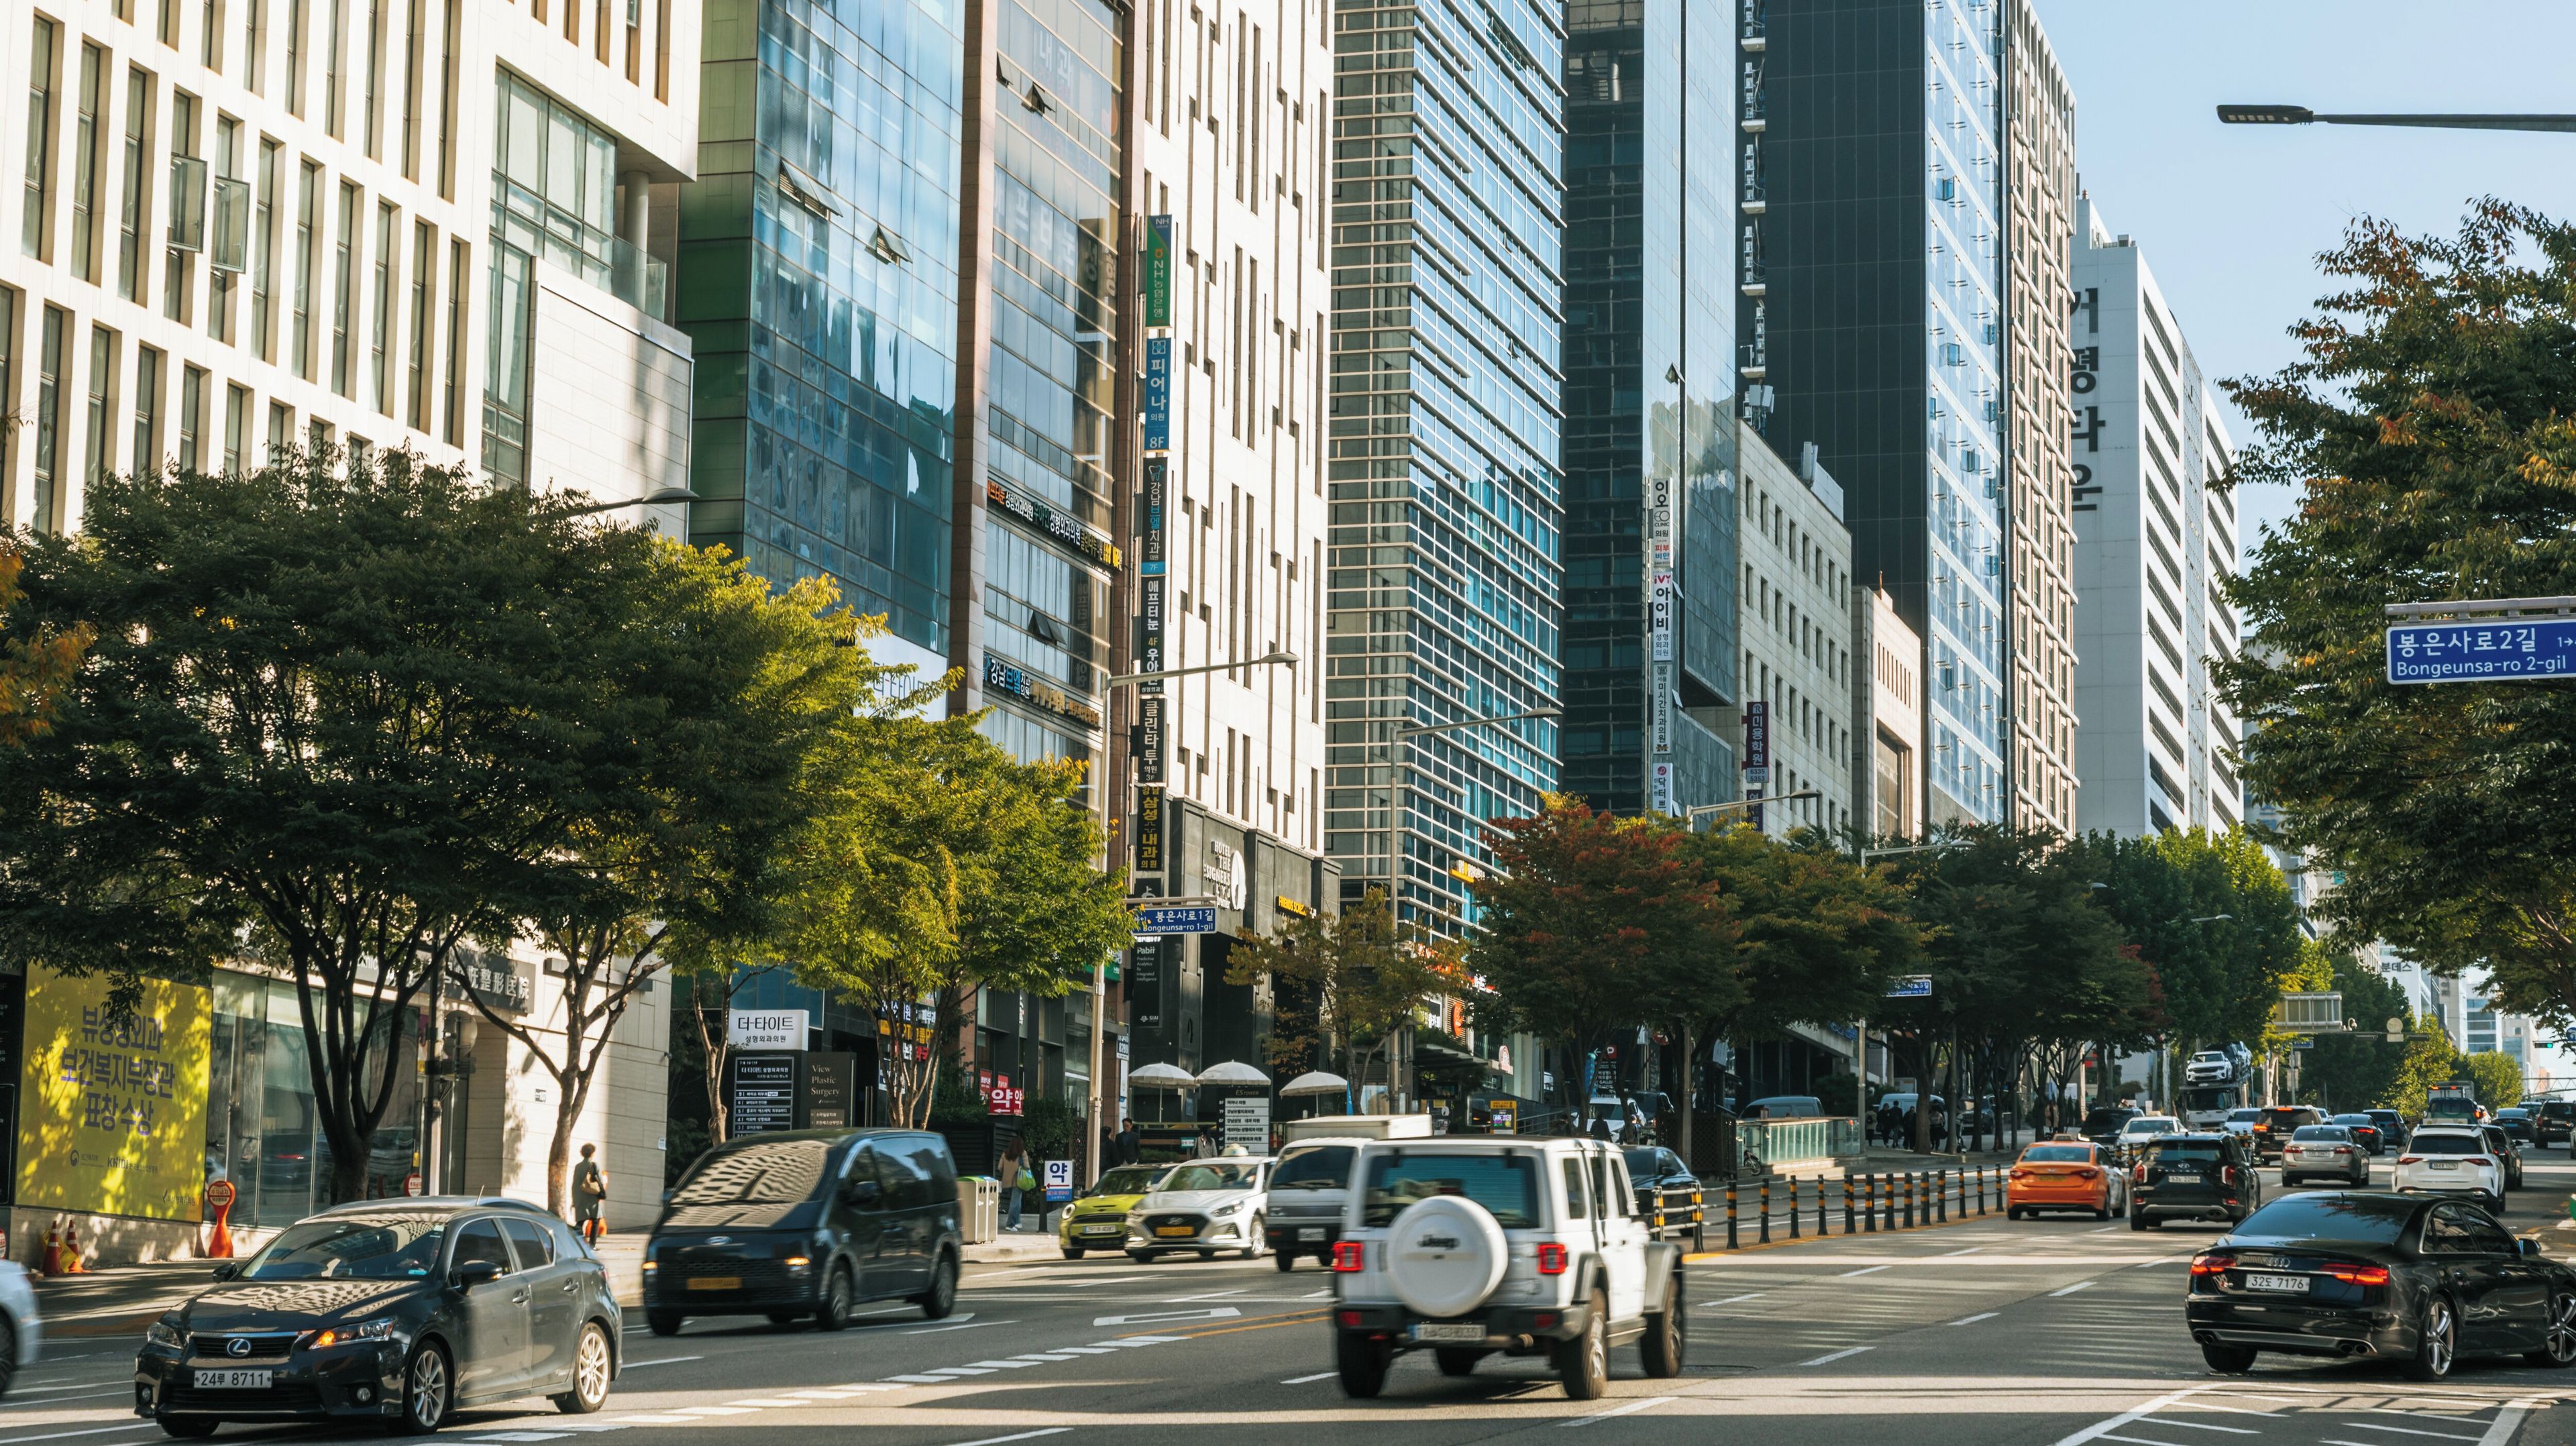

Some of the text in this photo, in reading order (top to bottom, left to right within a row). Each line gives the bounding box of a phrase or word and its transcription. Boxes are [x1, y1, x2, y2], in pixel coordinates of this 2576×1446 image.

[1150, 359, 1166, 410] 피어나
[1150, 413, 1165, 421] 의원
[1150, 437, 1165, 449] 8F
[1655, 481, 1668, 508] 이오
[1050, 511, 1080, 546] 성형외과의원
[1148, 580, 1159, 630] 애프터눈
[1656, 588, 1670, 630] 아이비
[1148, 637, 1158, 646] 4F
[2396, 628, 2536, 657] 봉은사로2길
[1656, 649, 1669, 657] 의원
[2397, 655, 2566, 677] Bongeunsa-ro 2-gil
[1658, 683, 1666, 743] 미시간치과의원
[1144, 701, 1159, 765] 클린타투
[1752, 716, 1763, 766] 미용학원
[1144, 765, 1157, 773] 의원
[1142, 786, 1159, 795] 강남
[1658, 777, 1666, 813] 닥터쁘
[1143, 797, 1158, 821] 삼성
[1142, 834, 1157, 858] 내과
[1214, 840, 1230, 857] HOTEL
[1141, 860, 1157, 869] 의원
[1219, 855, 1230, 871] THE
[1155, 909, 1213, 923] 봉은사로1길
[1197, 923, 1213, 932] 1-gil
[745, 1035, 786, 1043] 성형외과의원
[60, 1047, 175, 1099] 보건복지부장관
[812, 1064, 831, 1072] View
[812, 1076, 837, 1084] Plastic
[810, 1087, 840, 1097] Surgery
[991, 1089, 1013, 1108] 약
[85, 1093, 154, 1136] 표창 수상
[1050, 1162, 1067, 1183] 약
[2251, 1276, 2304, 1289] 32도 7176
[201, 1372, 264, 1386] 24루 8711
